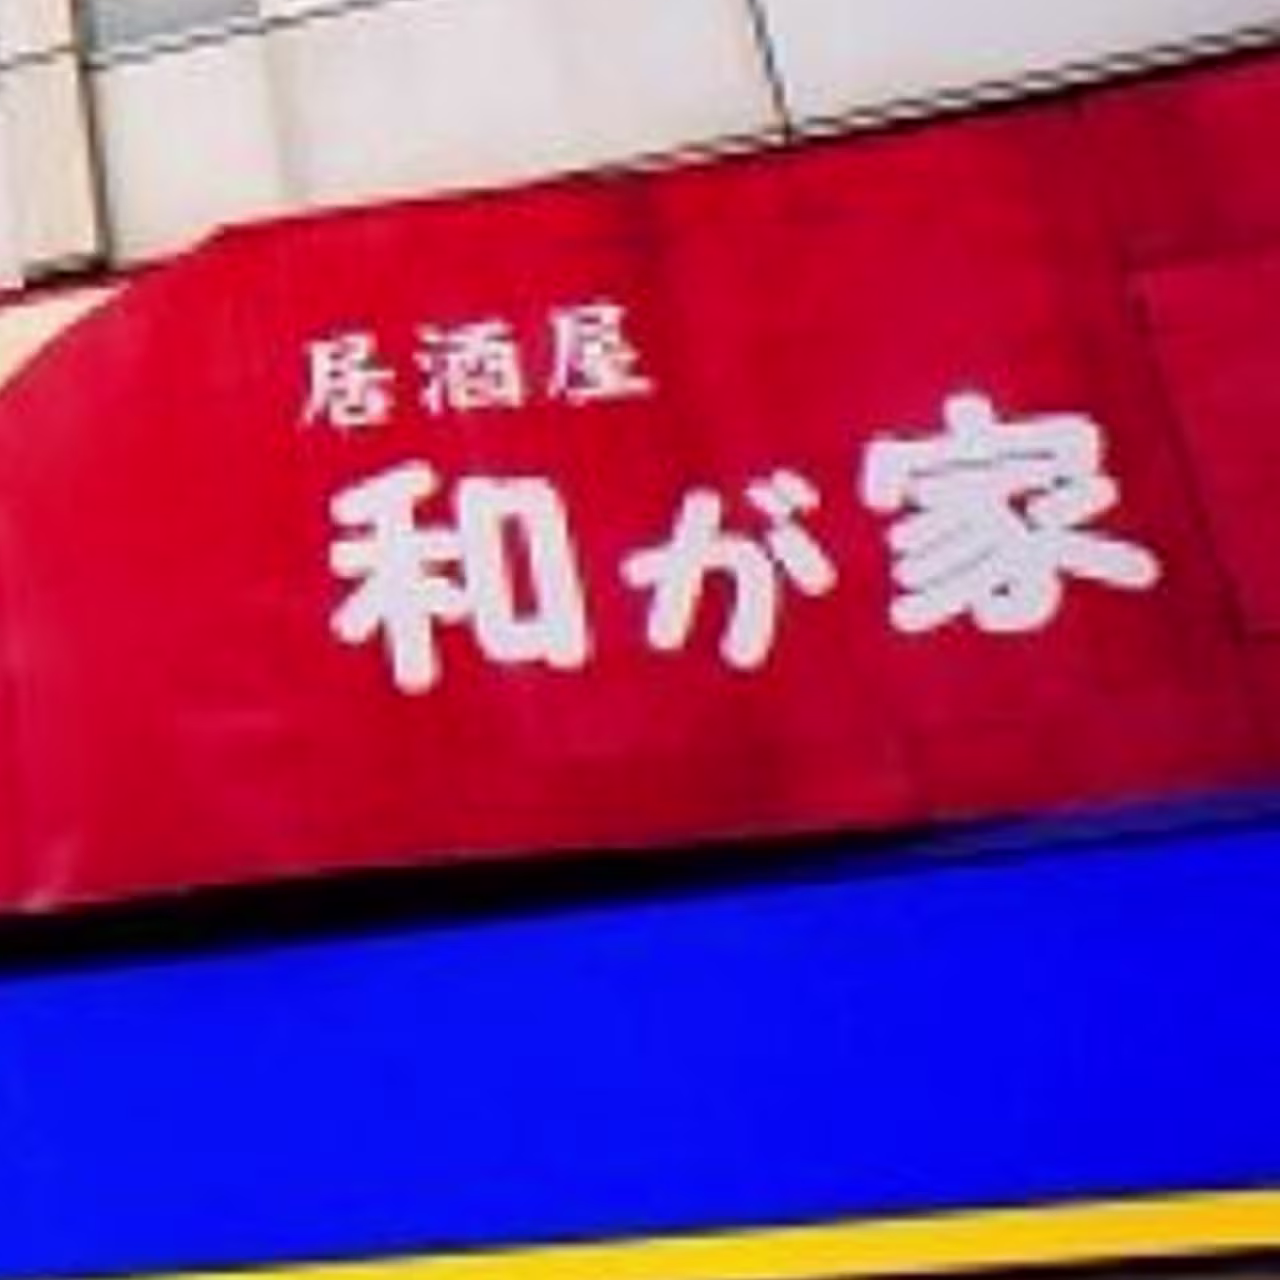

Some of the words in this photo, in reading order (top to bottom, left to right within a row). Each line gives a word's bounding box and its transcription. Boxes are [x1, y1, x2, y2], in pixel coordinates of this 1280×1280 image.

[301, 300, 653, 428] 居酒屋
[328, 391, 1161, 695] 和が家
